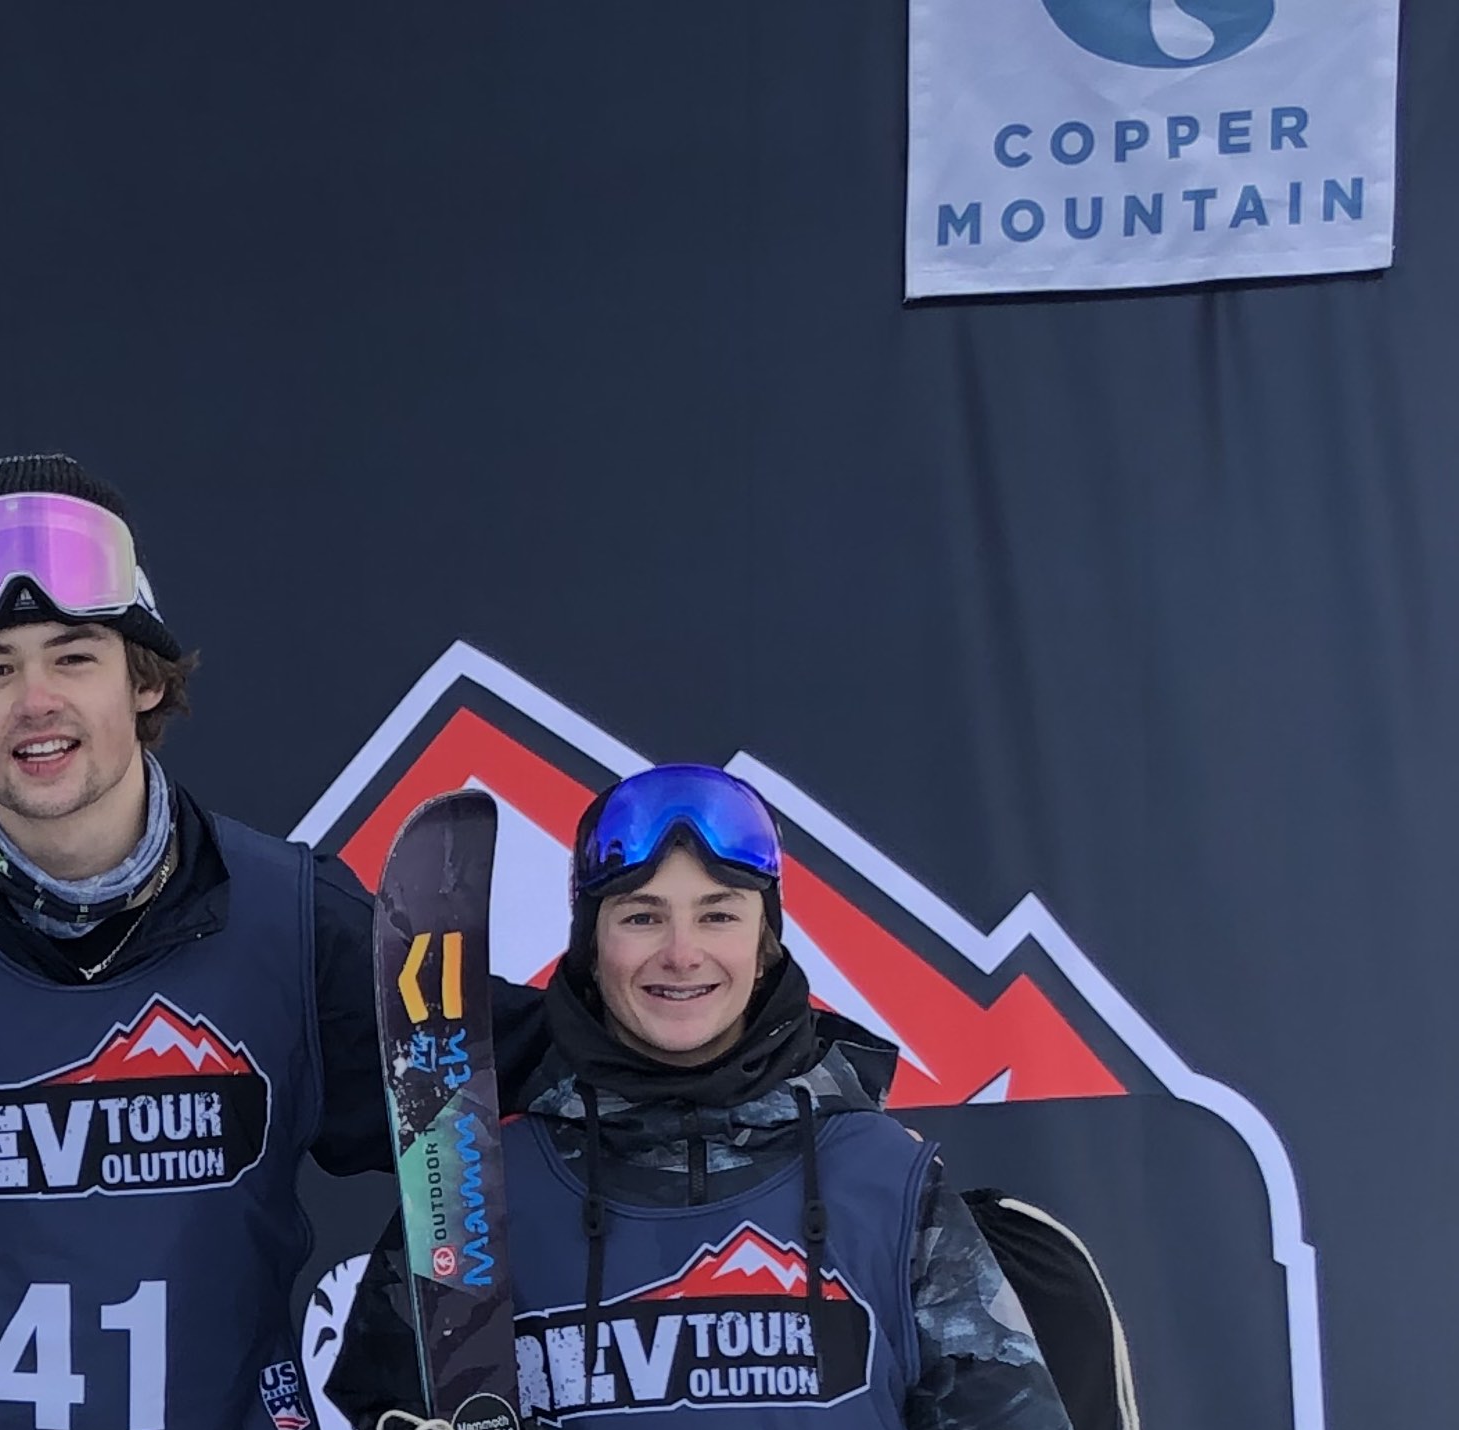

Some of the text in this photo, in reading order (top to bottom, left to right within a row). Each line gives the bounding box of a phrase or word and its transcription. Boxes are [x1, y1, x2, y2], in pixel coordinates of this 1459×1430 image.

[993, 105, 1311, 169] COPPER
[935, 176, 1365, 248] MOUNTAIN
[98, 1091, 223, 1144] TOUR
[101, 1146, 225, 1184] OLUTION
[425, 1142, 448, 1242] OUTDOOR
[685, 1311, 816, 1359] TOUR
[262, 1363, 297, 1391] US
[688, 1365, 820, 1398] OLUTION
